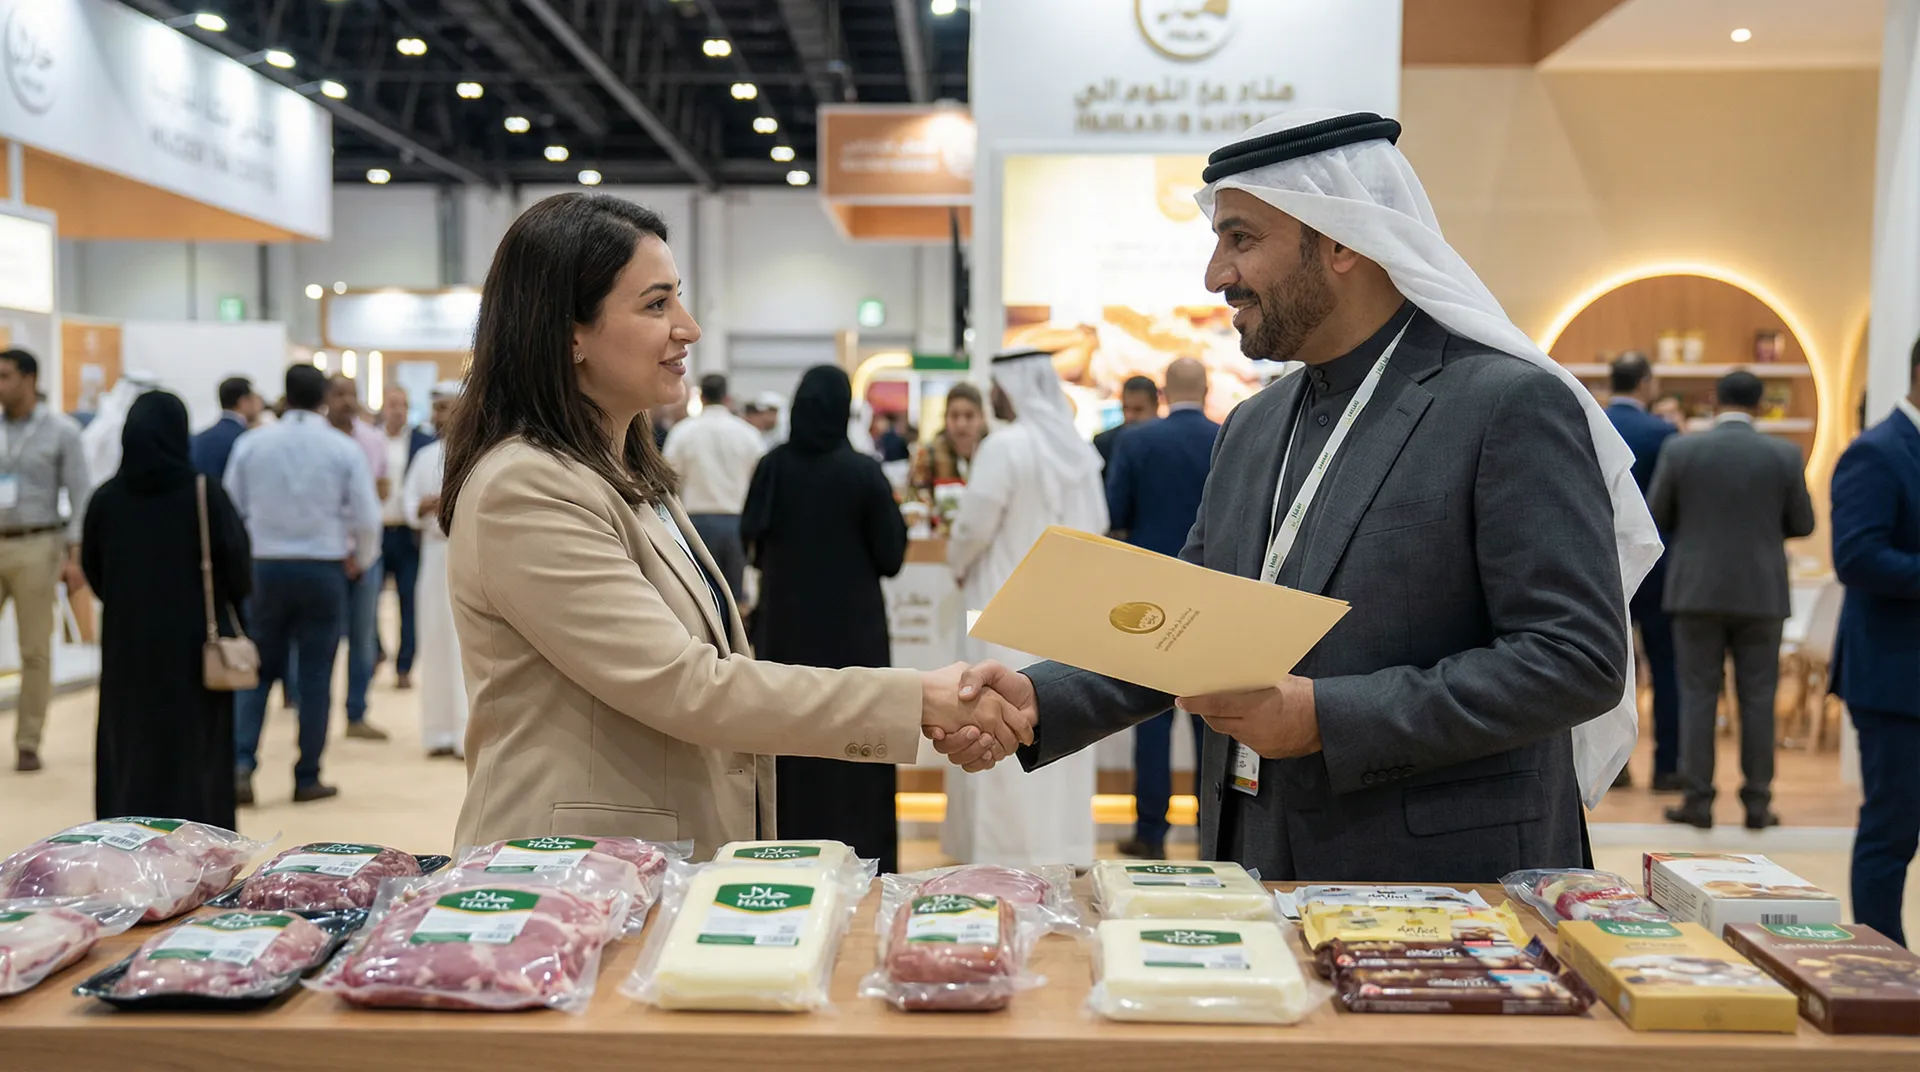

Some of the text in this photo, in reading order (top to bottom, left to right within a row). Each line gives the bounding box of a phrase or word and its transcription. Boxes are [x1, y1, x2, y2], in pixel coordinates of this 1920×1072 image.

[461, 890, 515, 902] حلال
[738, 885, 791, 899] حلال
[460, 901, 510, 909] HALAL
[737, 898, 787, 908] HALAL
